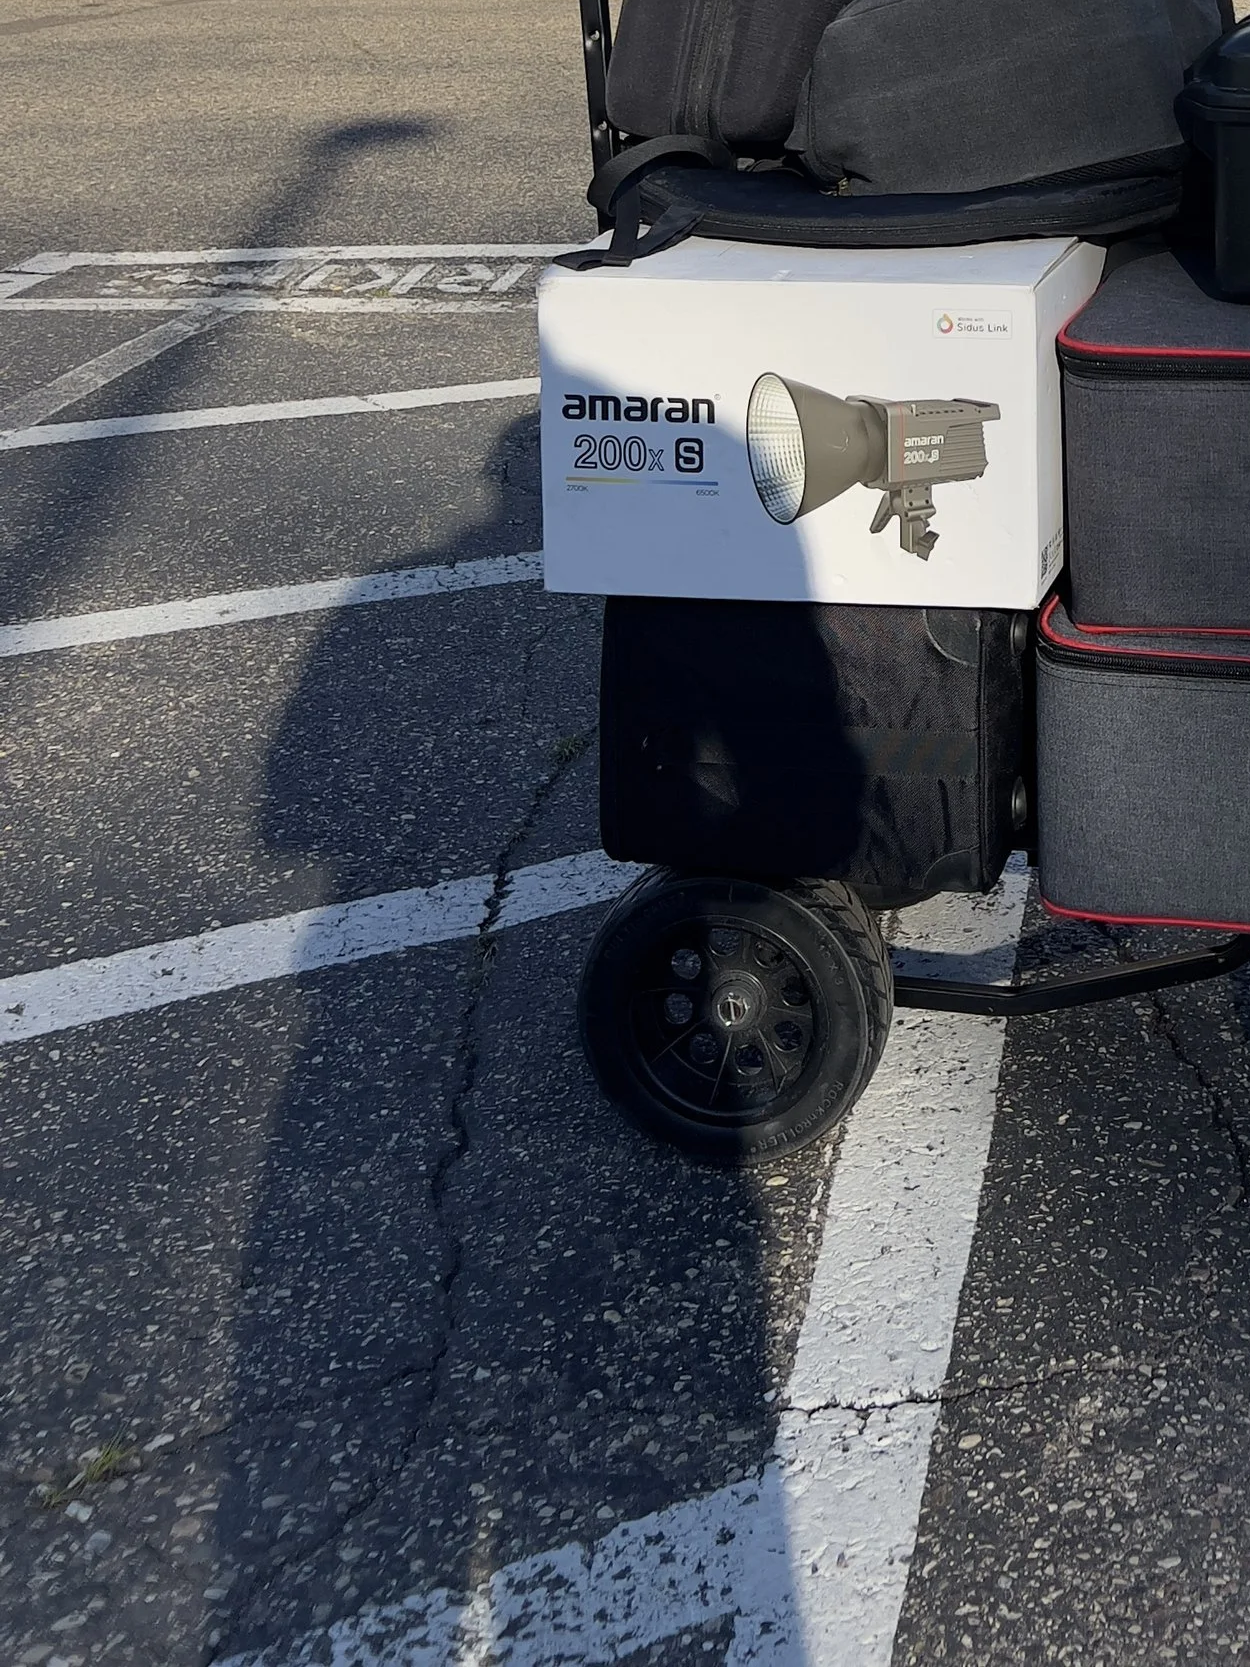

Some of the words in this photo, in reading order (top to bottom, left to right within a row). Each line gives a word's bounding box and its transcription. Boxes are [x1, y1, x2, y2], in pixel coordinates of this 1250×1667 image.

[957, 322, 985, 332] Sidus
[987, 324, 1008, 333] Link
[903, 434, 945, 448] amaran
[676, 439, 702, 472] S
[566, 484, 589, 492] 2700K
[695, 488, 720, 497] 6500K
